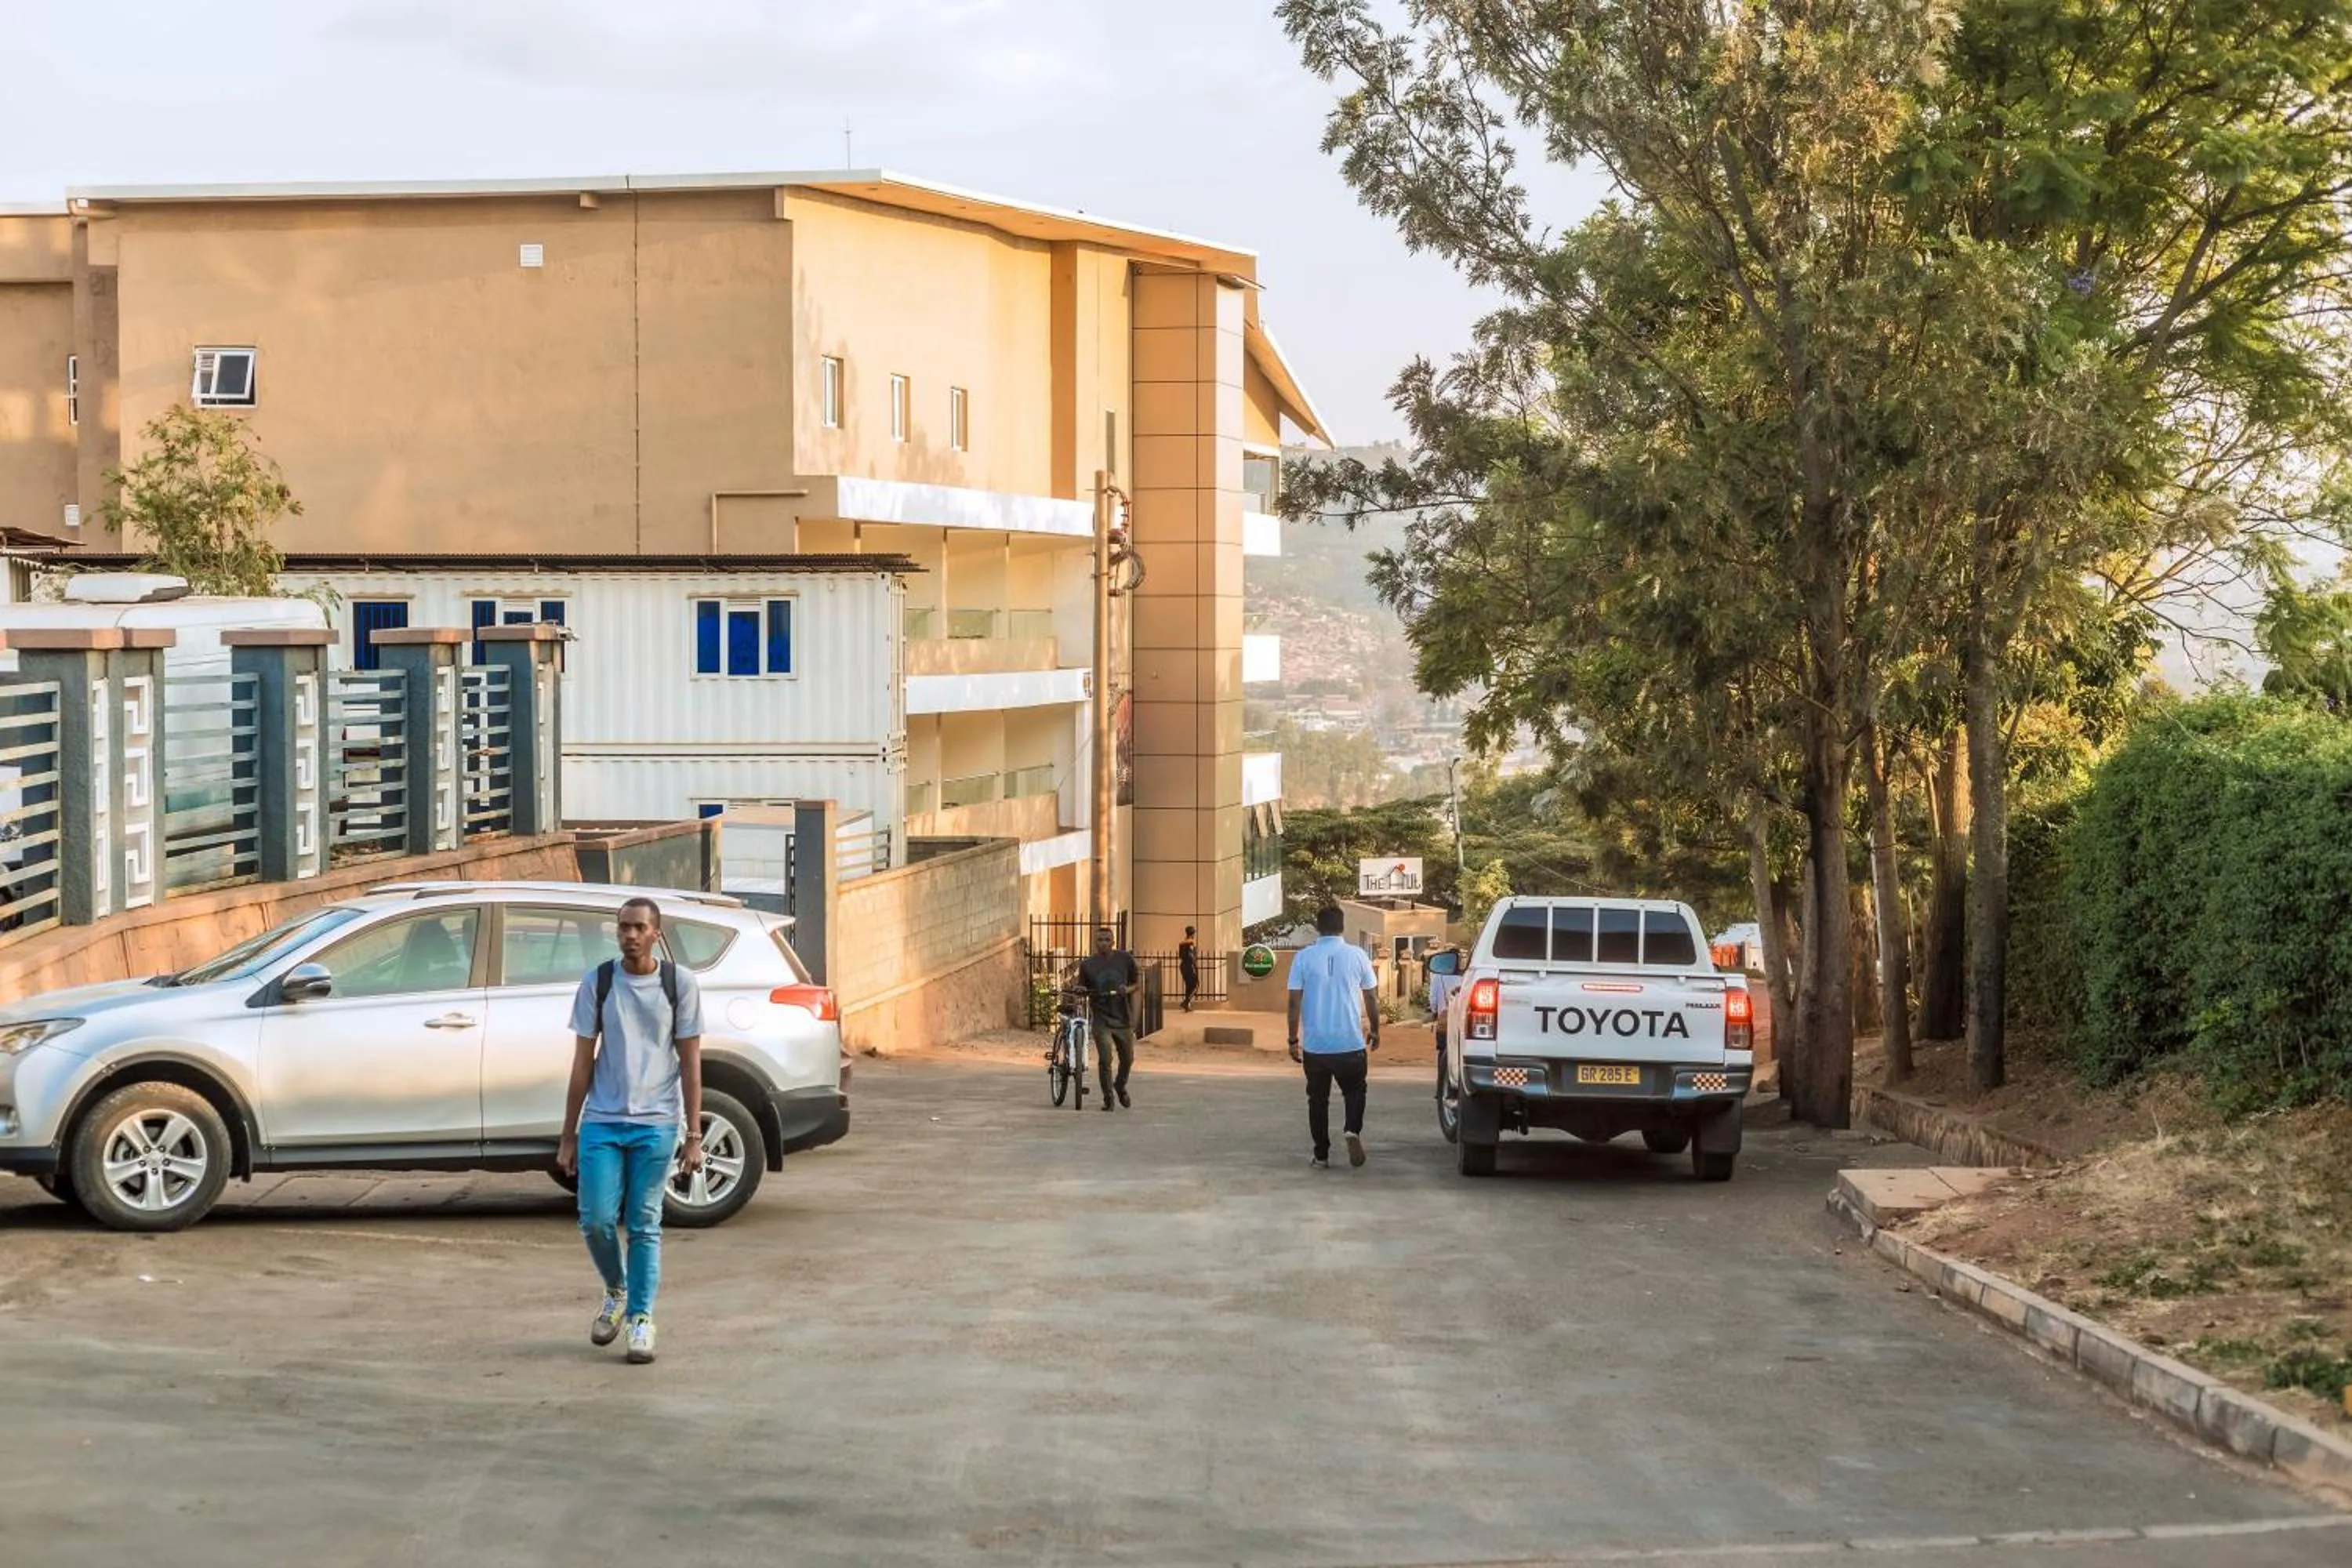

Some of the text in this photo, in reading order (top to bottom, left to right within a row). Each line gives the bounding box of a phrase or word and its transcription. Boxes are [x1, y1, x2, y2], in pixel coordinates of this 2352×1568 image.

[1534, 1006, 1690, 1039] TOYOTA
[1581, 1067, 1598, 1081] GR
[1599, 1067, 1622, 1081] 285
